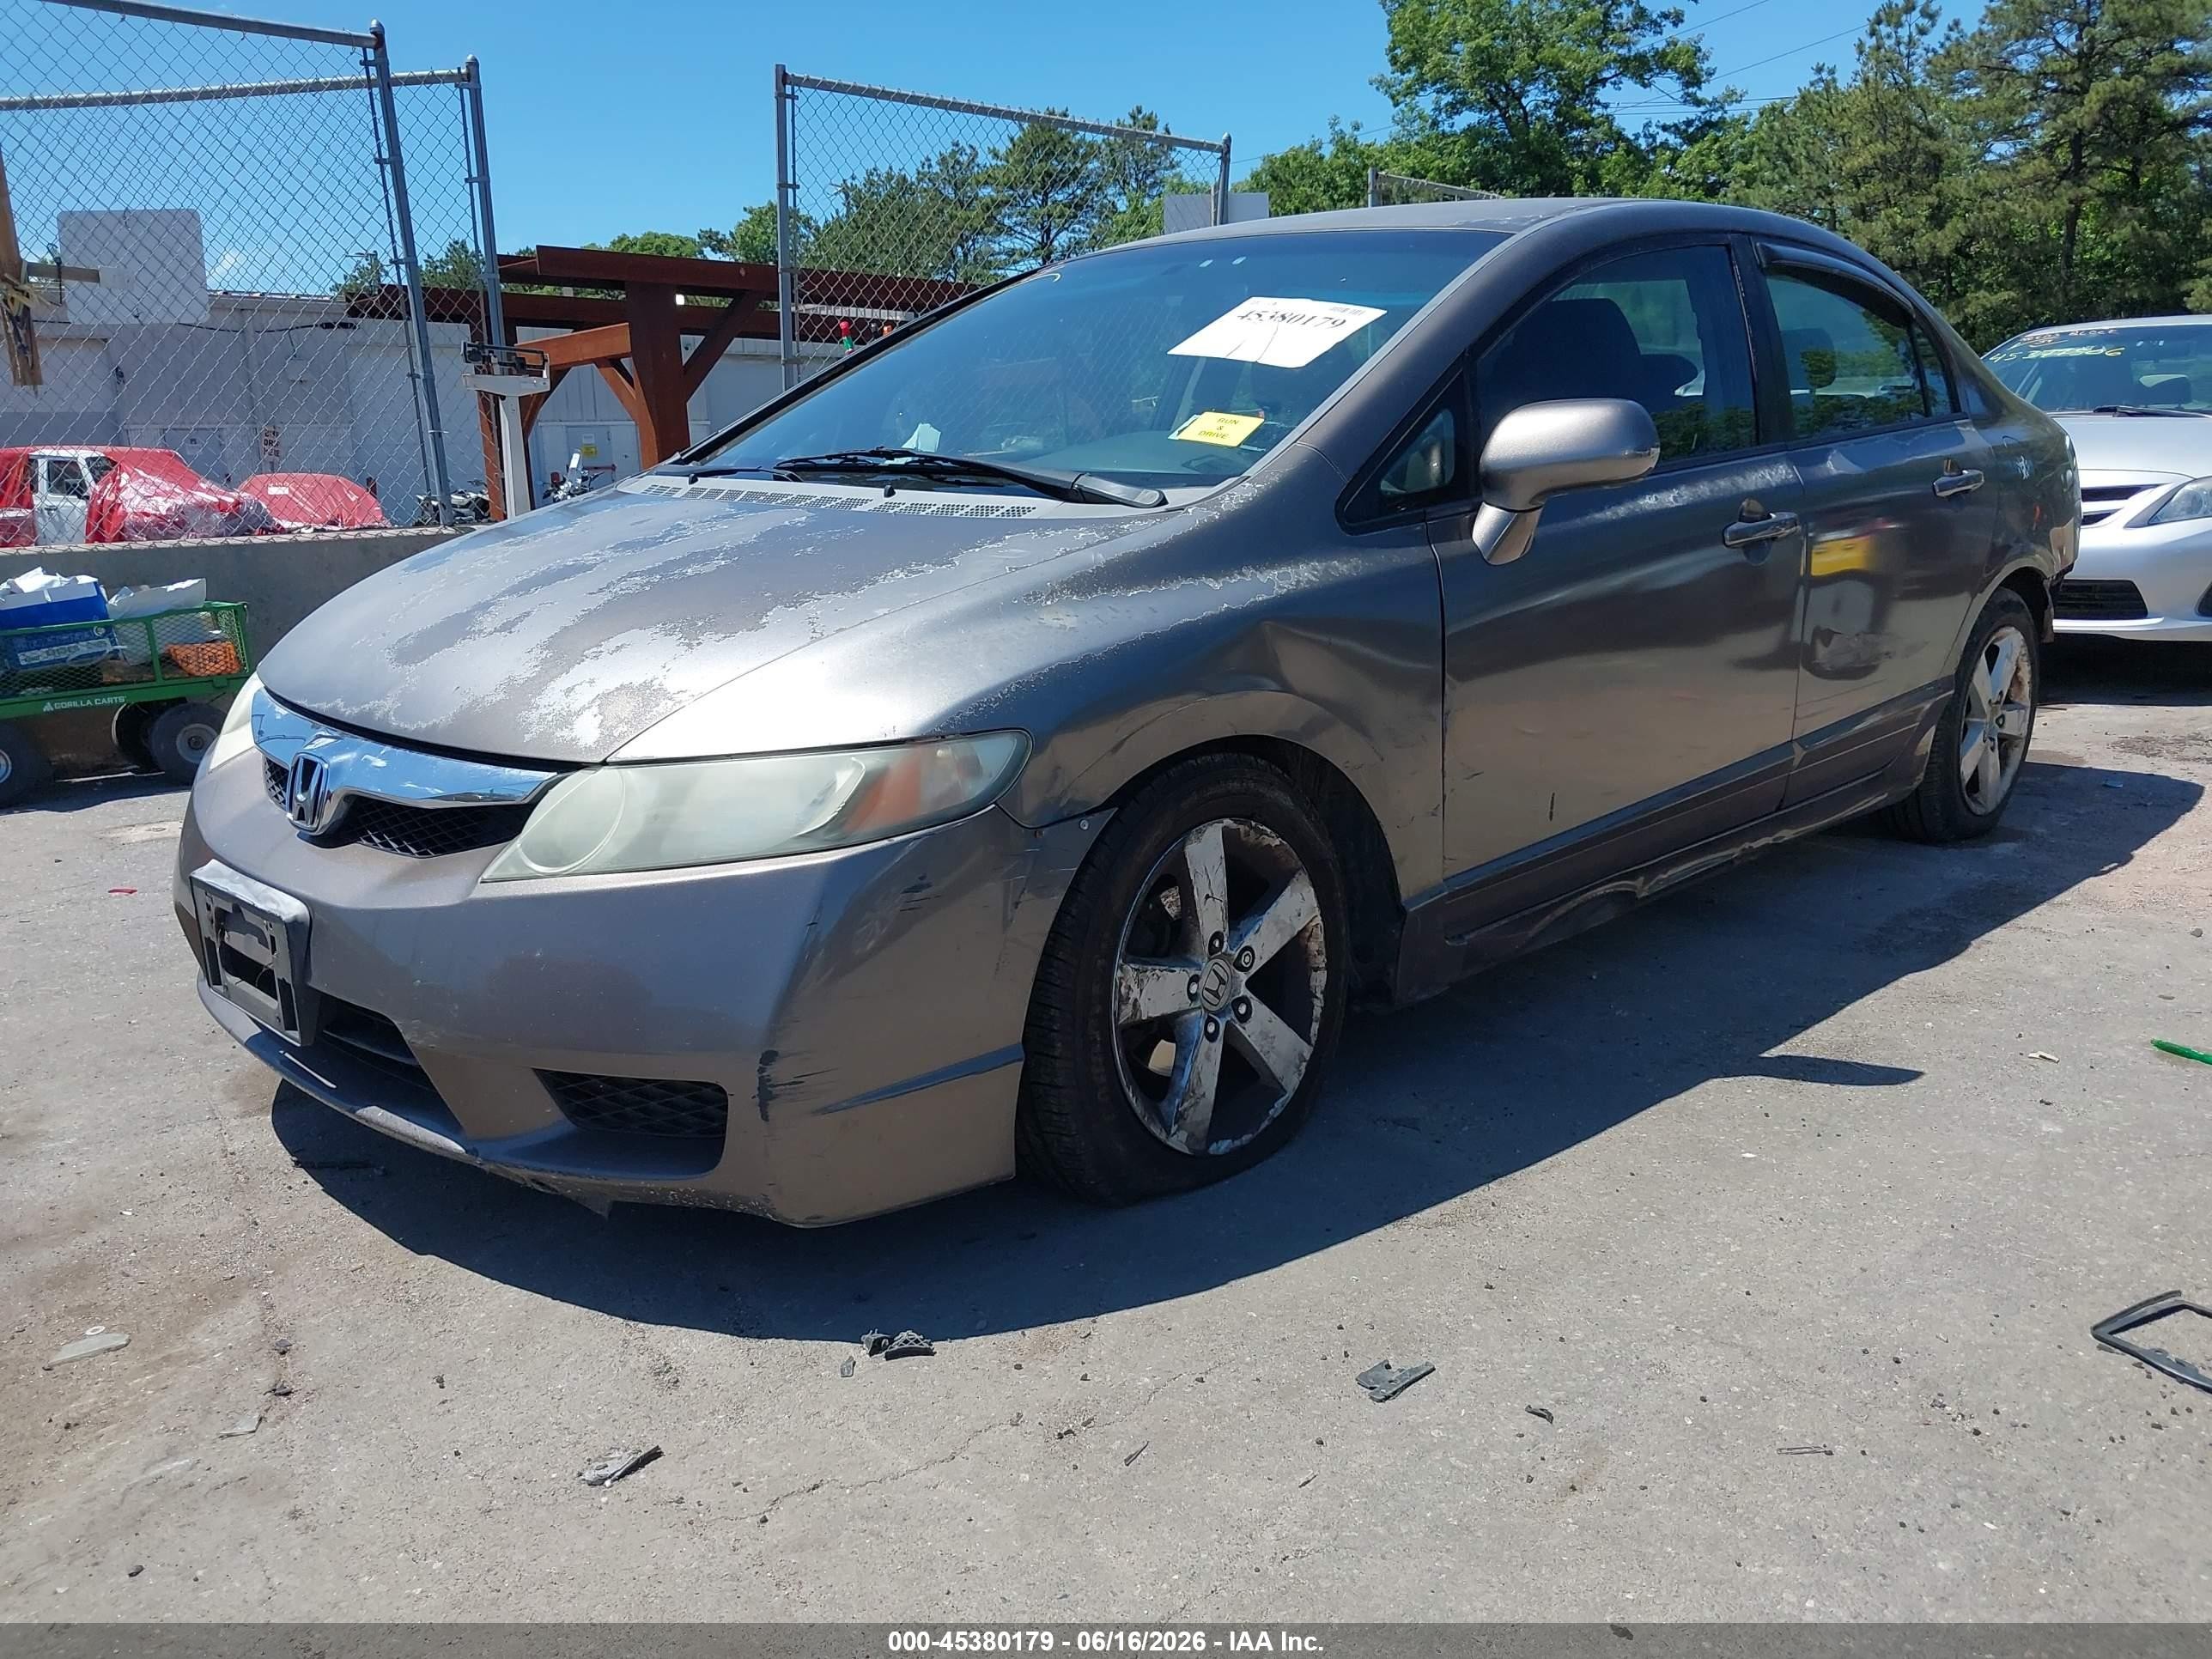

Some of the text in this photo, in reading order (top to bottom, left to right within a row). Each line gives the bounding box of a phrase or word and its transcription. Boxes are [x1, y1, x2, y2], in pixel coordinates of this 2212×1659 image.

[1237, 309, 1347, 330] 45380179
[1216, 417, 1240, 426] RUN
[1197, 430, 1230, 440] DRIVE
[54, 696, 125, 710] GORILLA CARTS
